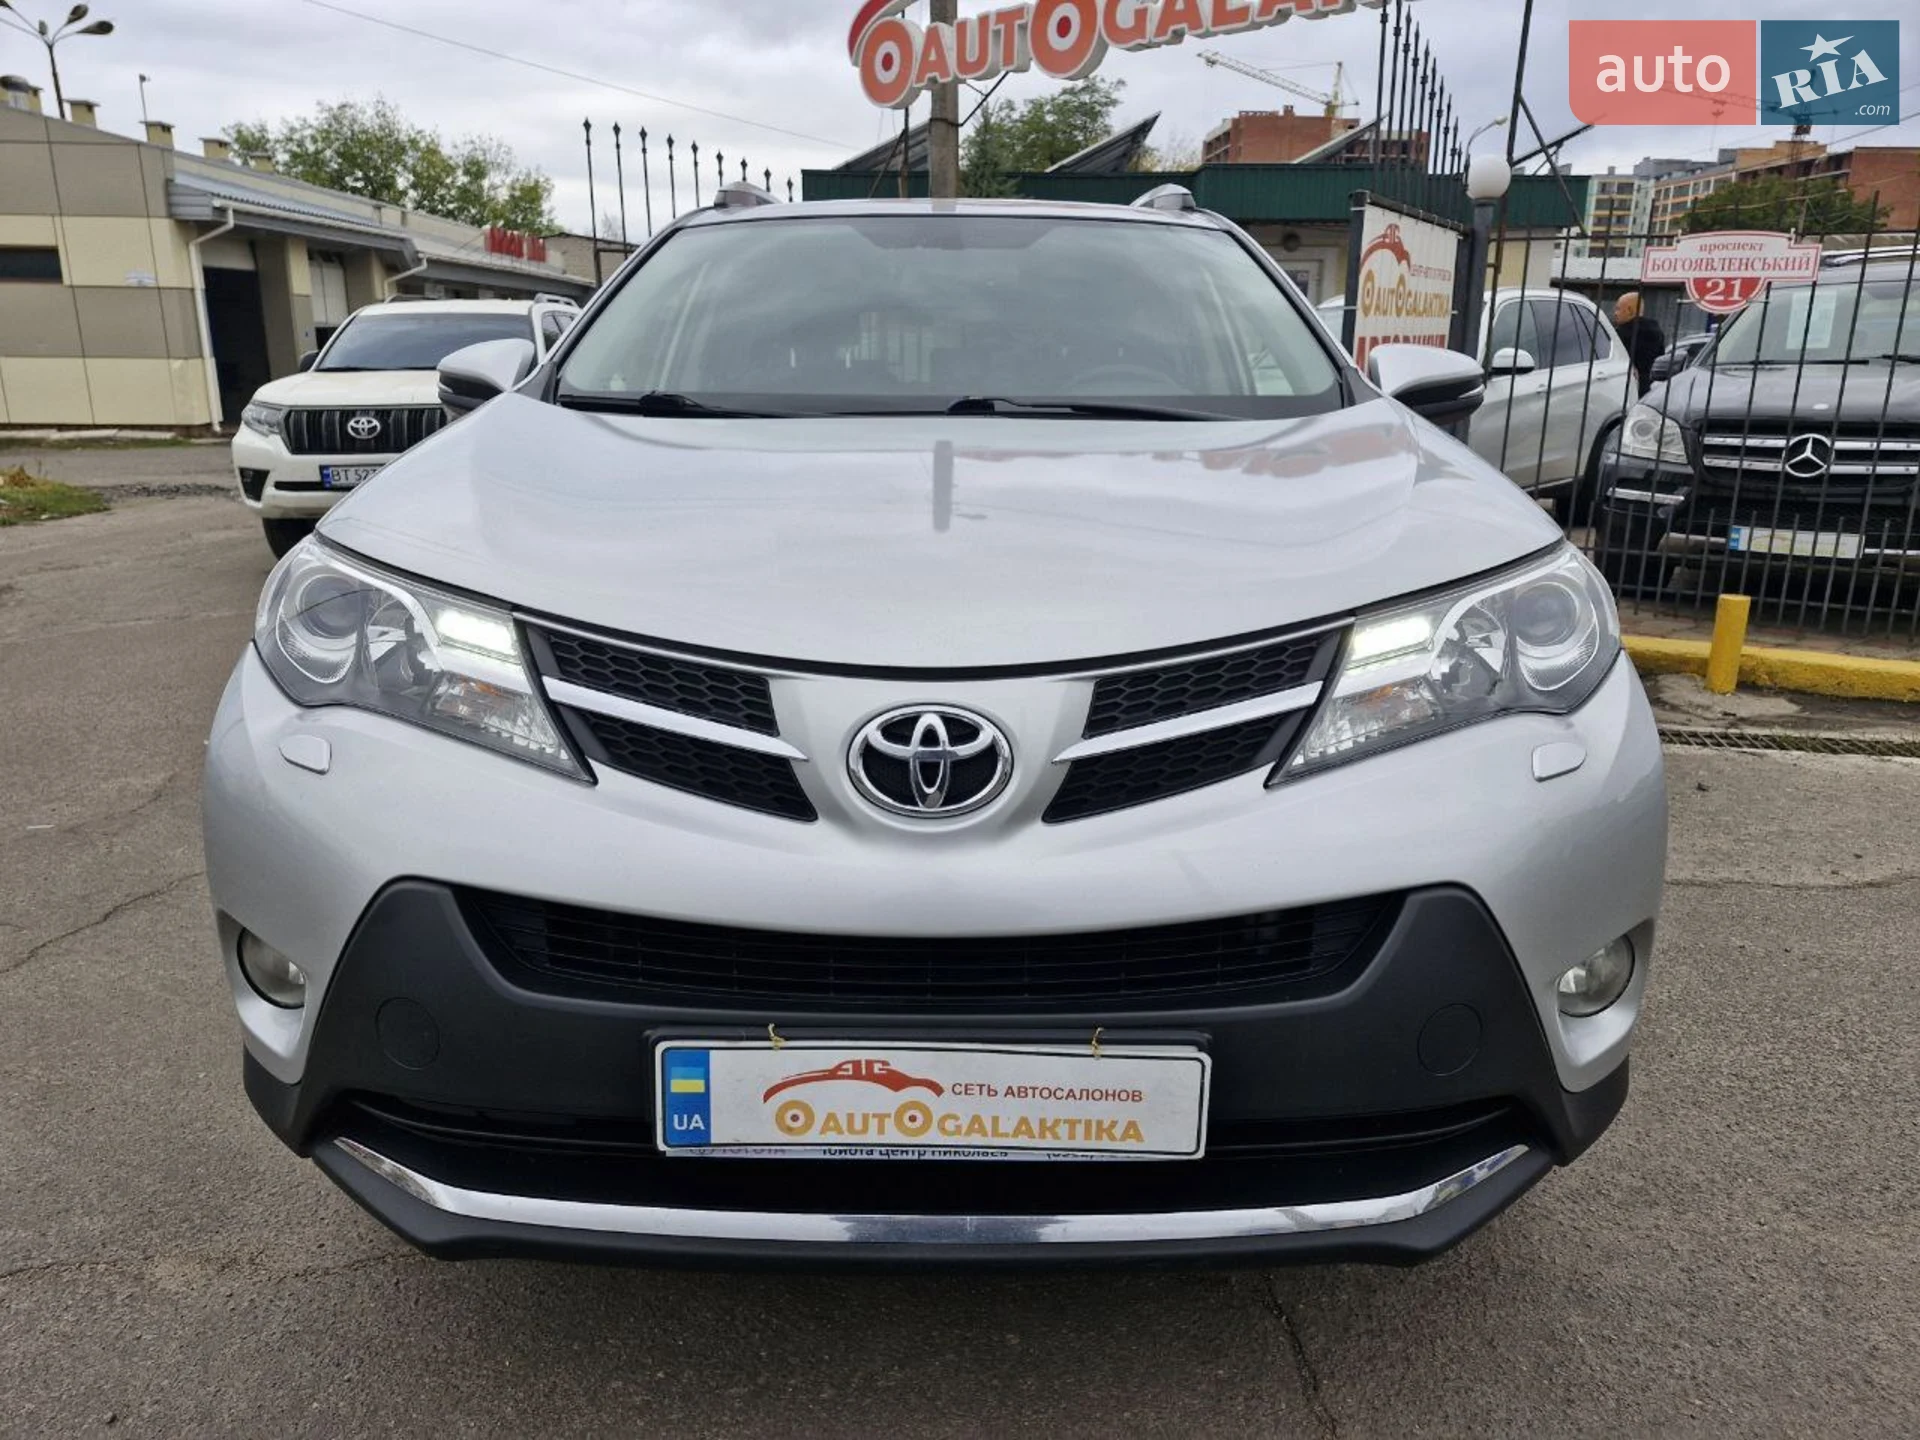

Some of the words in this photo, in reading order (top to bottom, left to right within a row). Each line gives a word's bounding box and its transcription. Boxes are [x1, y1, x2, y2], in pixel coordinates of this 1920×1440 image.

[1699, 242, 1764, 255] проспект
[1652, 253, 1811, 273] БОГОЯВЛЕНСЬКИЙ
[1704, 278, 1744, 301] 21
[951, 1082, 998, 1098] СЕТЬ
[1003, 1085, 1143, 1103] АВТОСАЛОНОВ
[673, 1113, 705, 1131] UA
